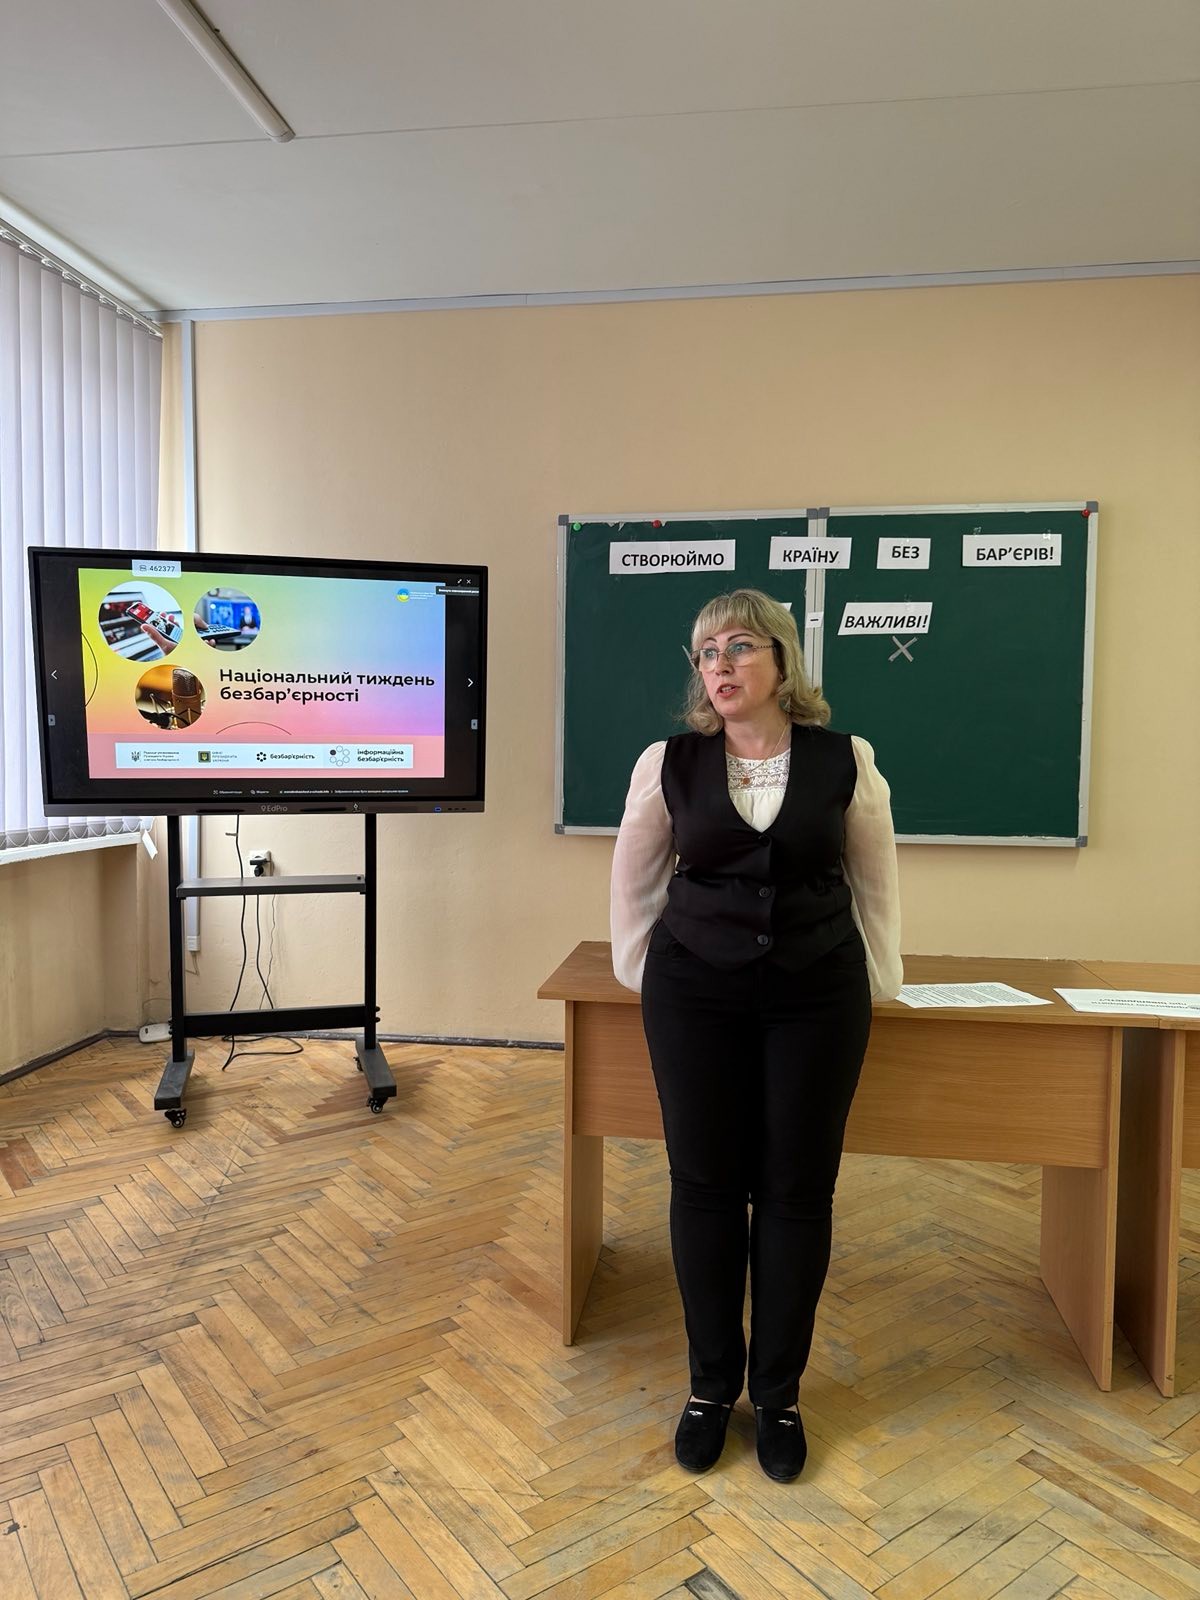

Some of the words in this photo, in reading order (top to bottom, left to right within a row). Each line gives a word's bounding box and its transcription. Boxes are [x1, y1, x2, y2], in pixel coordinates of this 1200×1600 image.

[622, 551, 724, 567] СТВОРЮЙМО
[783, 547, 839, 564] КРАЇНУ
[891, 545, 920, 559] БЕЗ
[976, 546, 1054, 561] БАР’ЄРІВ!
[149, 565, 175, 573] 462377
[844, 614, 929, 629] ВАЖЛИВІ!
[219, 669, 351, 685] Національний
[356, 674, 435, 687] тиждень
[220, 687, 359, 705] безбар’єрності
[266, 804, 288, 812] EdPro
